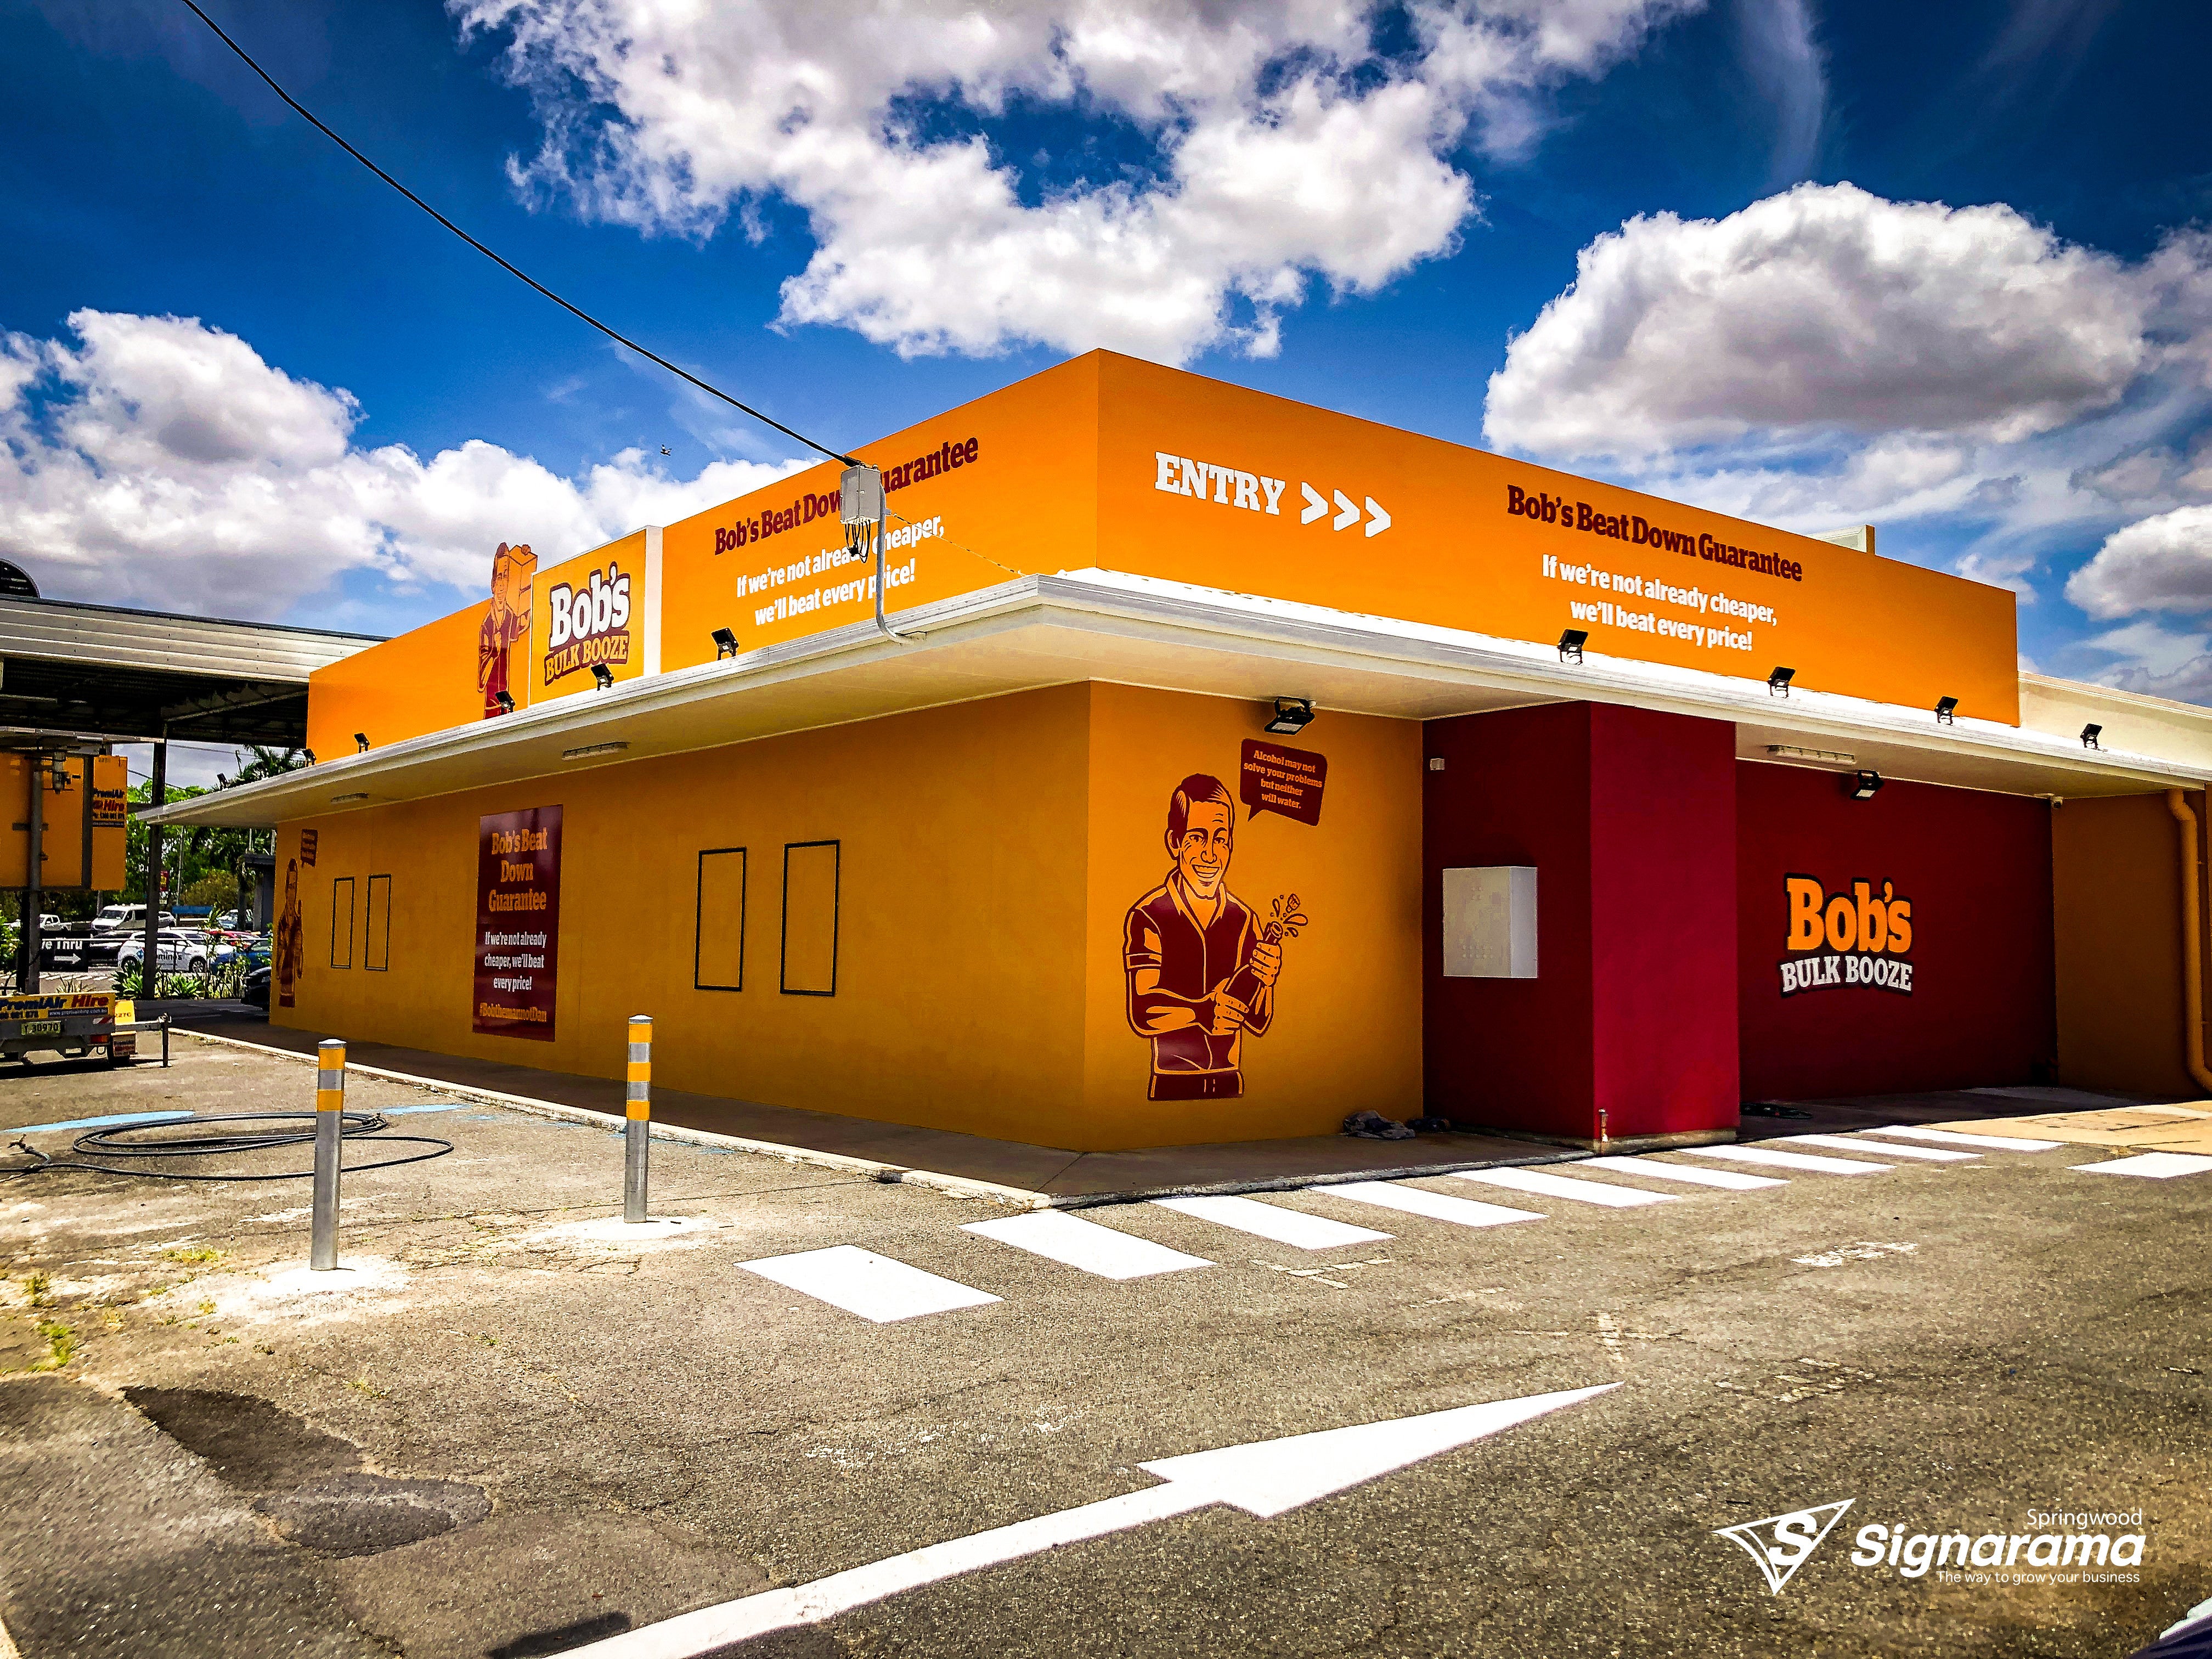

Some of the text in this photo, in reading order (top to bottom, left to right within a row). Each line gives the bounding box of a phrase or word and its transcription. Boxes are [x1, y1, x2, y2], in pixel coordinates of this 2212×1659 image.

[715, 437, 978, 555] Bob's Beat Dow uarantee
[1155, 452, 1285, 515] ENTRY
[1507, 484, 1802, 582] Bob's Beat Down Guarantee
[737, 575, 747, 597] If
[748, 567, 785, 593] we're
[787, 558, 811, 580] not
[755, 558, 915, 625] we'll beat every pice!
[1542, 554, 1778, 627] If we're not already cheaper,
[550, 566, 629, 648] Bob's
[1570, 601, 1753, 652] we'll beat every price!
[546, 635, 629, 681] BULK BOOZE
[1243, 763, 1323, 788] solve your problems
[1254, 750, 1316, 773] Alcohol may not
[1261, 778, 1303, 795] but neither
[1262, 793, 1301, 809] will water.
[492, 827, 548, 855] Bob's Beat
[500, 860, 533, 882] Down
[489, 888, 546, 912] Guarantee
[1787, 878, 1912, 953] Bob's
[485, 932, 546, 949] If we're not already
[484, 953, 544, 969] cheaper, we'll beat
[1780, 955, 1913, 992] BULK BOOZE
[494, 975, 532, 992] every price!
